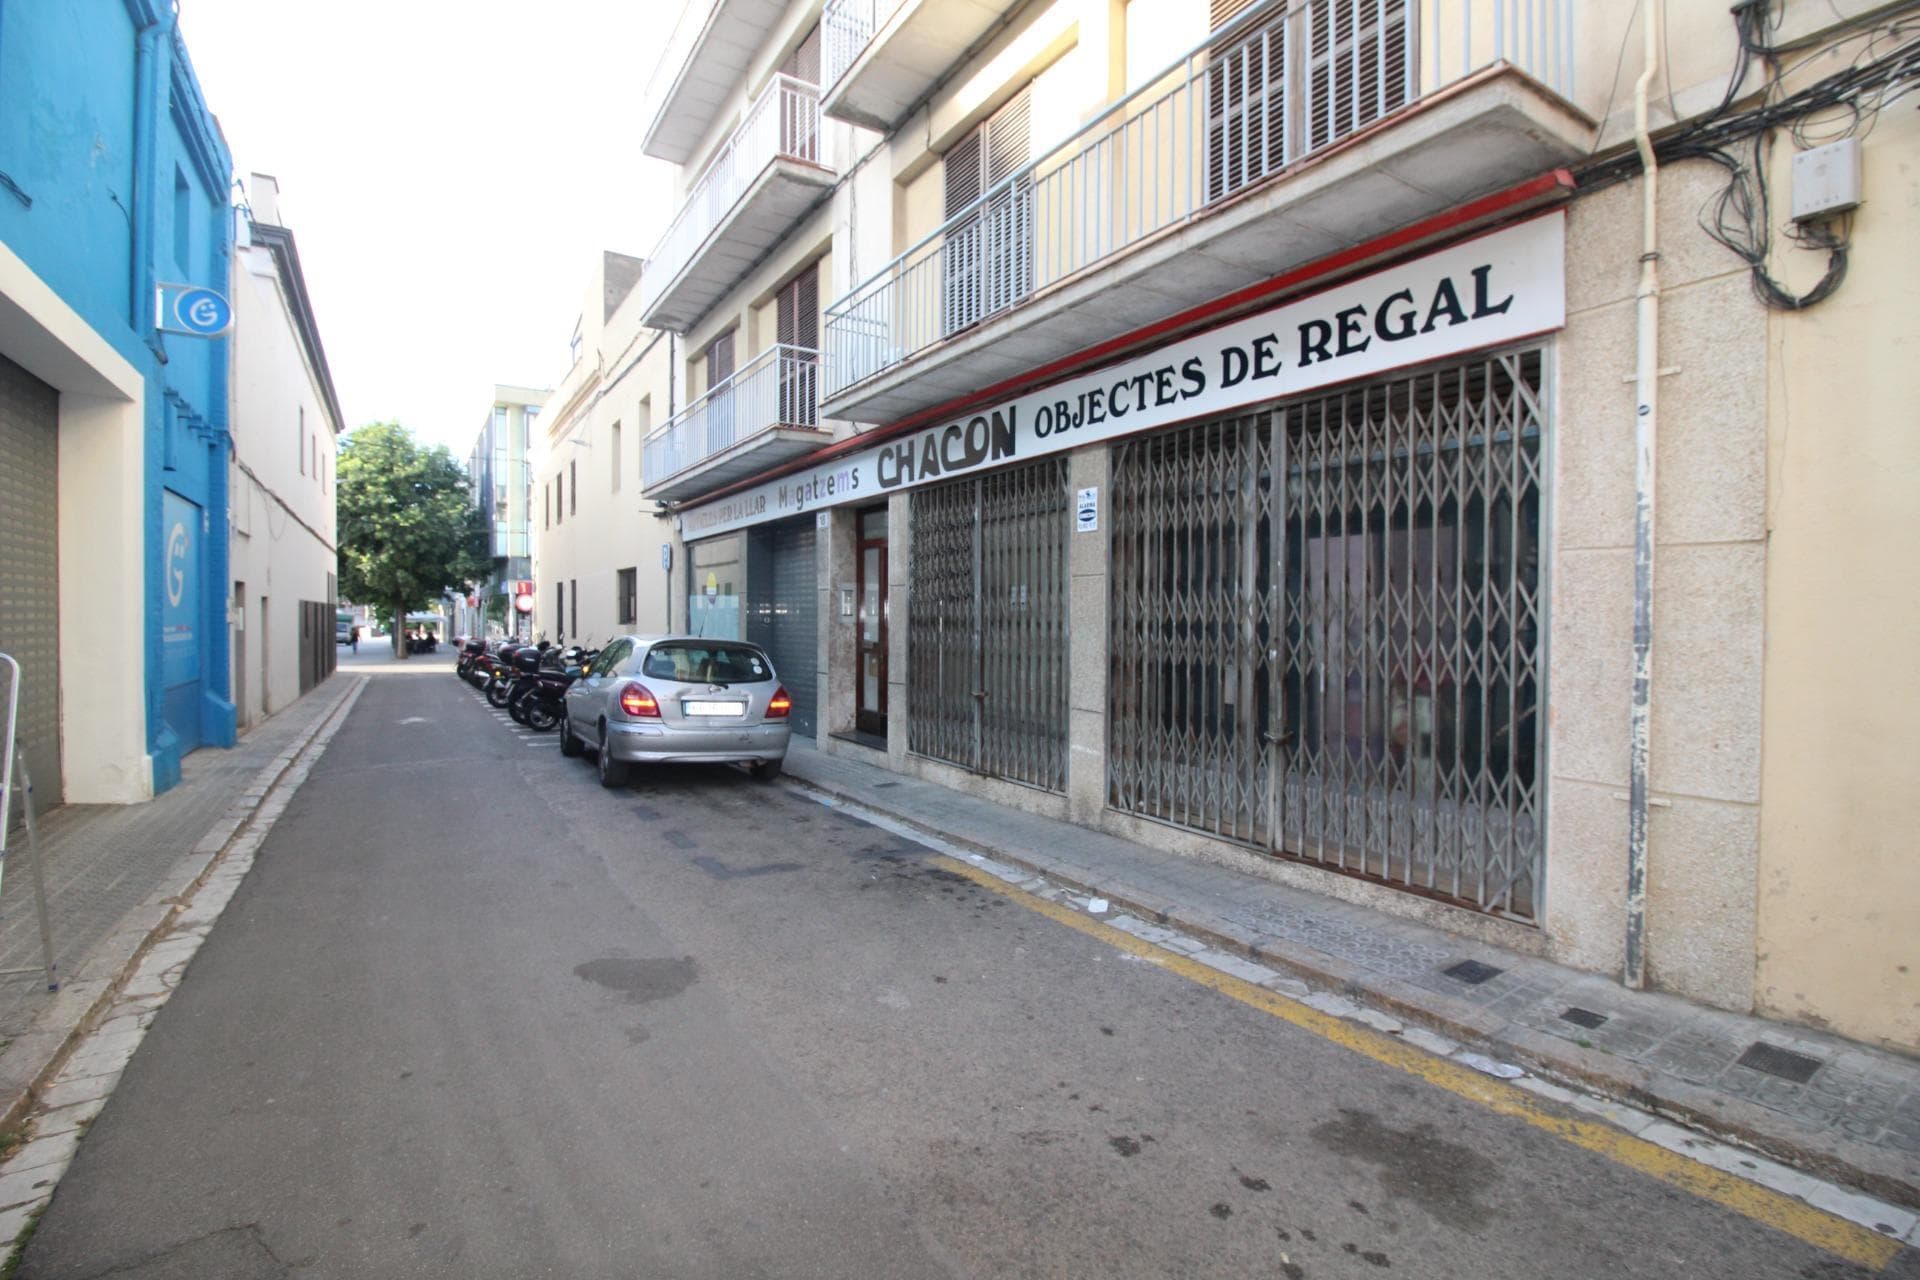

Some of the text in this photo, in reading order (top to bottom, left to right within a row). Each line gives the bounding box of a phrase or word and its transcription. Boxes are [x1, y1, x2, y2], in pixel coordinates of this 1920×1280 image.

[1034, 264, 1514, 439] OBJECTES DE REGAL
[779, 405, 1016, 511] Magatzems CHACON
